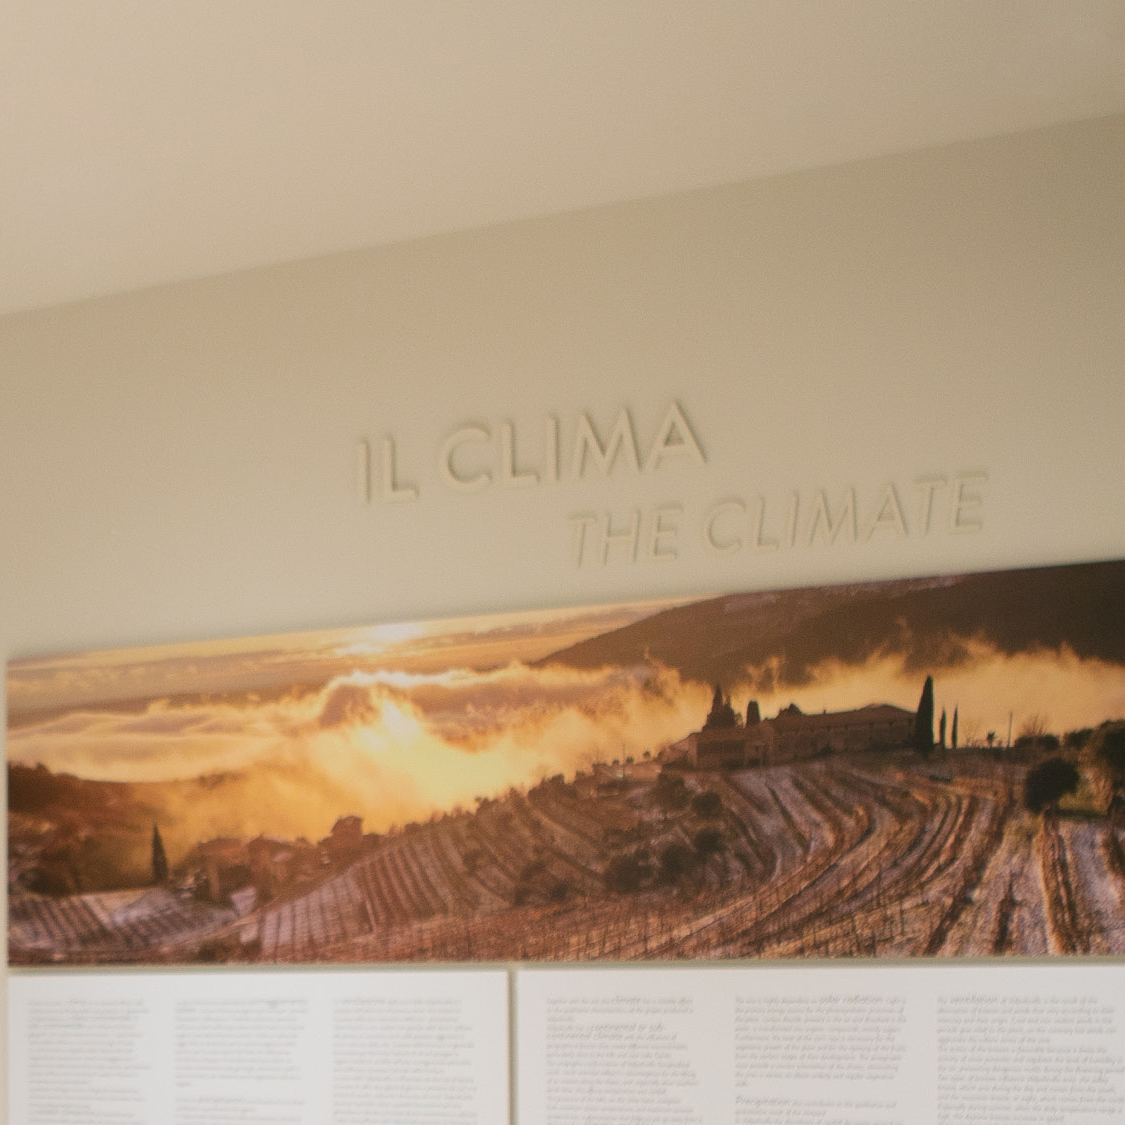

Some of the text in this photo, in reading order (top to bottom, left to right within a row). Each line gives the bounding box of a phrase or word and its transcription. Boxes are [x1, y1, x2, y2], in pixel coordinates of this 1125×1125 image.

[359, 400, 709, 503] IL CLIMA
[569, 470, 988, 569] THE CLIMATE
